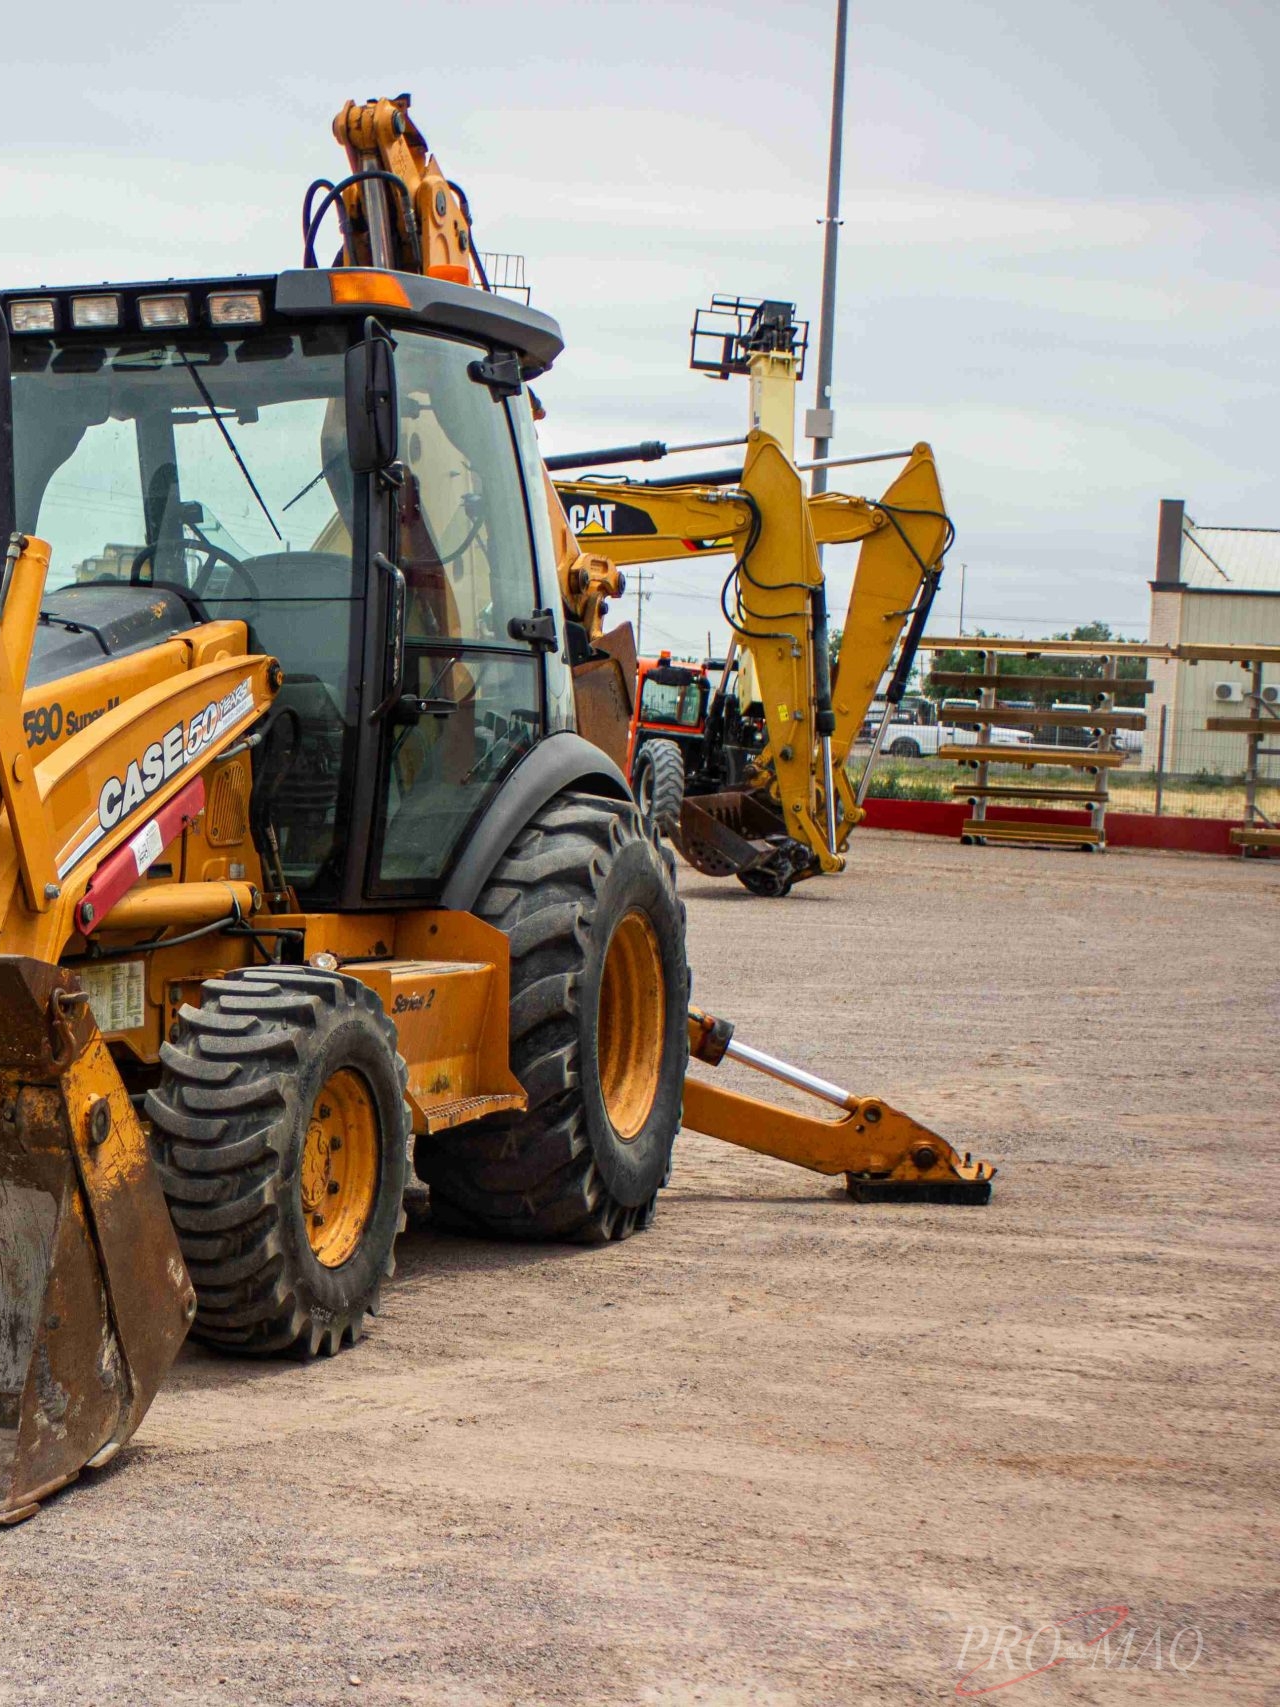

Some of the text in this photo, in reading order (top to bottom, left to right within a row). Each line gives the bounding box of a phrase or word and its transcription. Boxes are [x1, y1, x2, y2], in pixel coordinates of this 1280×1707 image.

[569, 504, 616, 535] CAT
[23, 702, 63, 749] 590
[98, 721, 185, 830] CASE
[187, 700, 218, 756] 50
[391, 989, 435, 1014] Series 2
